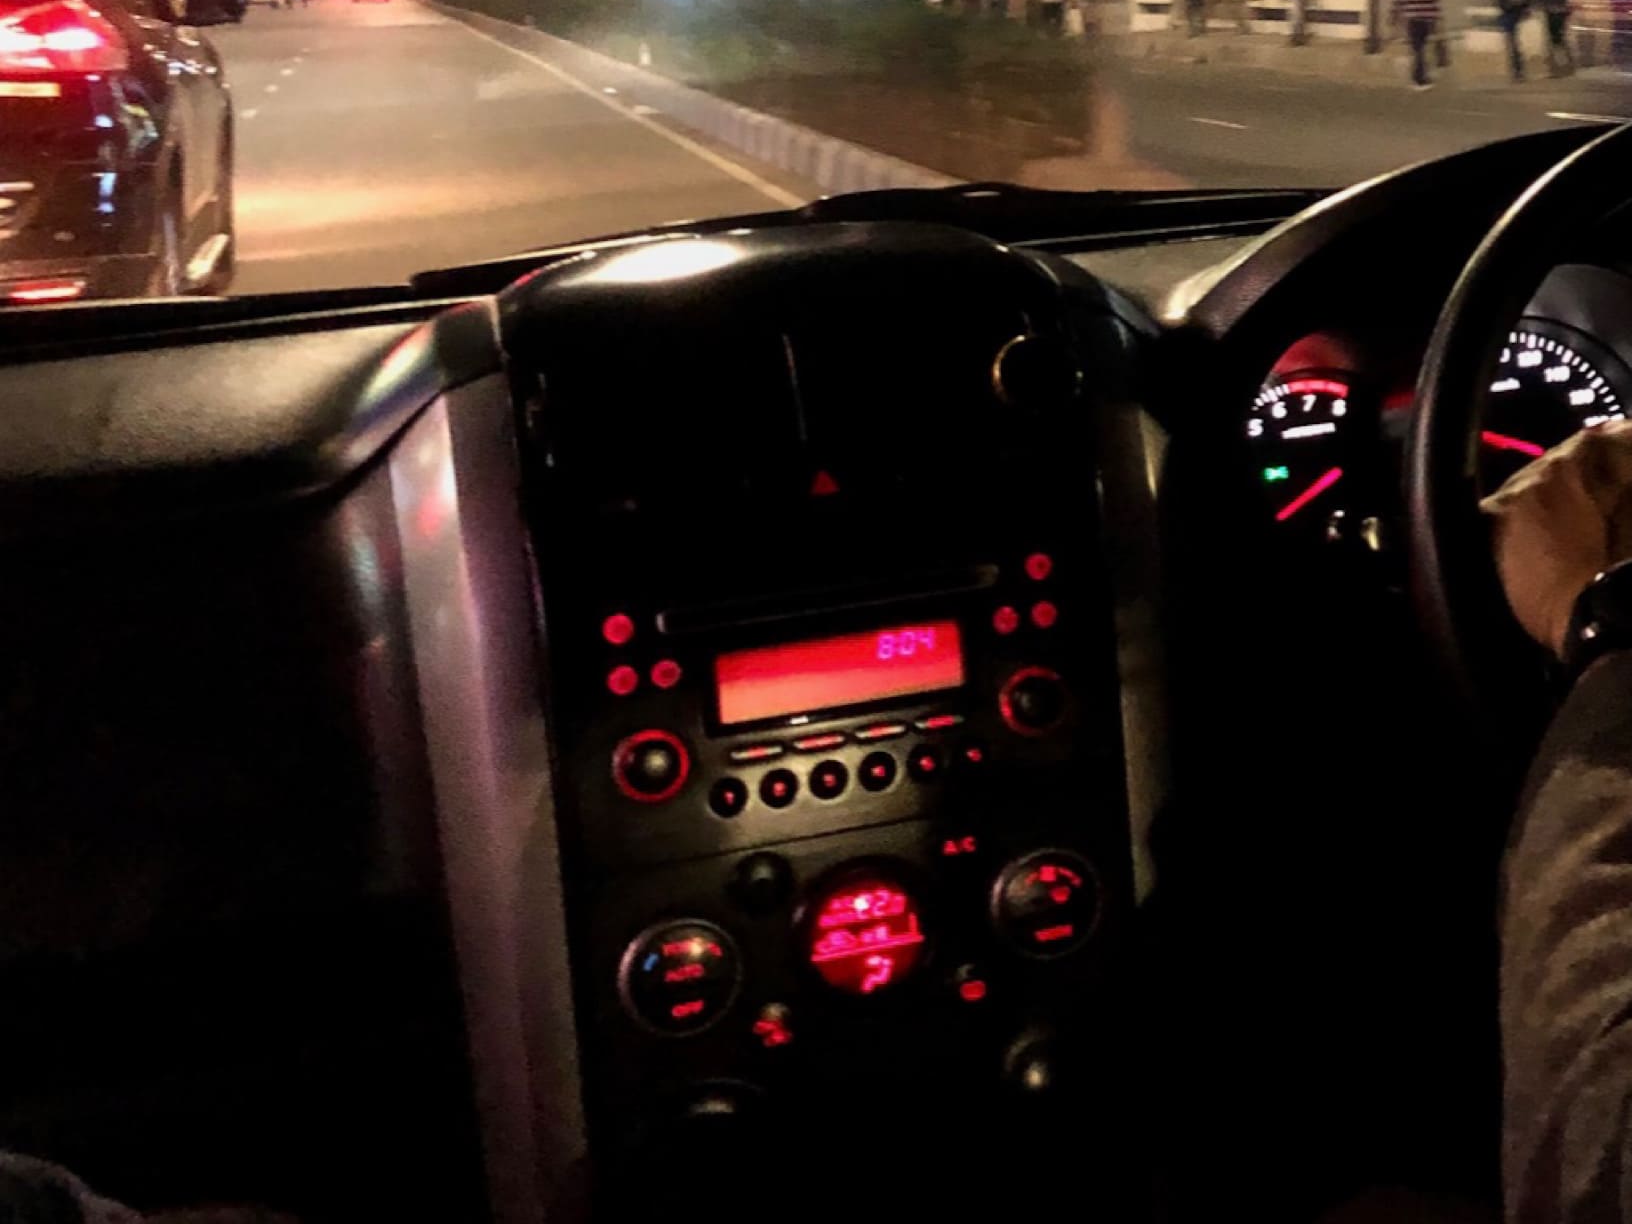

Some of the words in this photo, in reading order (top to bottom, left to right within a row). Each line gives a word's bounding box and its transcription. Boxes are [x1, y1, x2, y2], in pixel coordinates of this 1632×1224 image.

[1271, 400, 1288, 419] 6
[1302, 394, 1317, 412] 7
[1331, 398, 1347, 417] 8
[1247, 418, 1264, 437] 5
